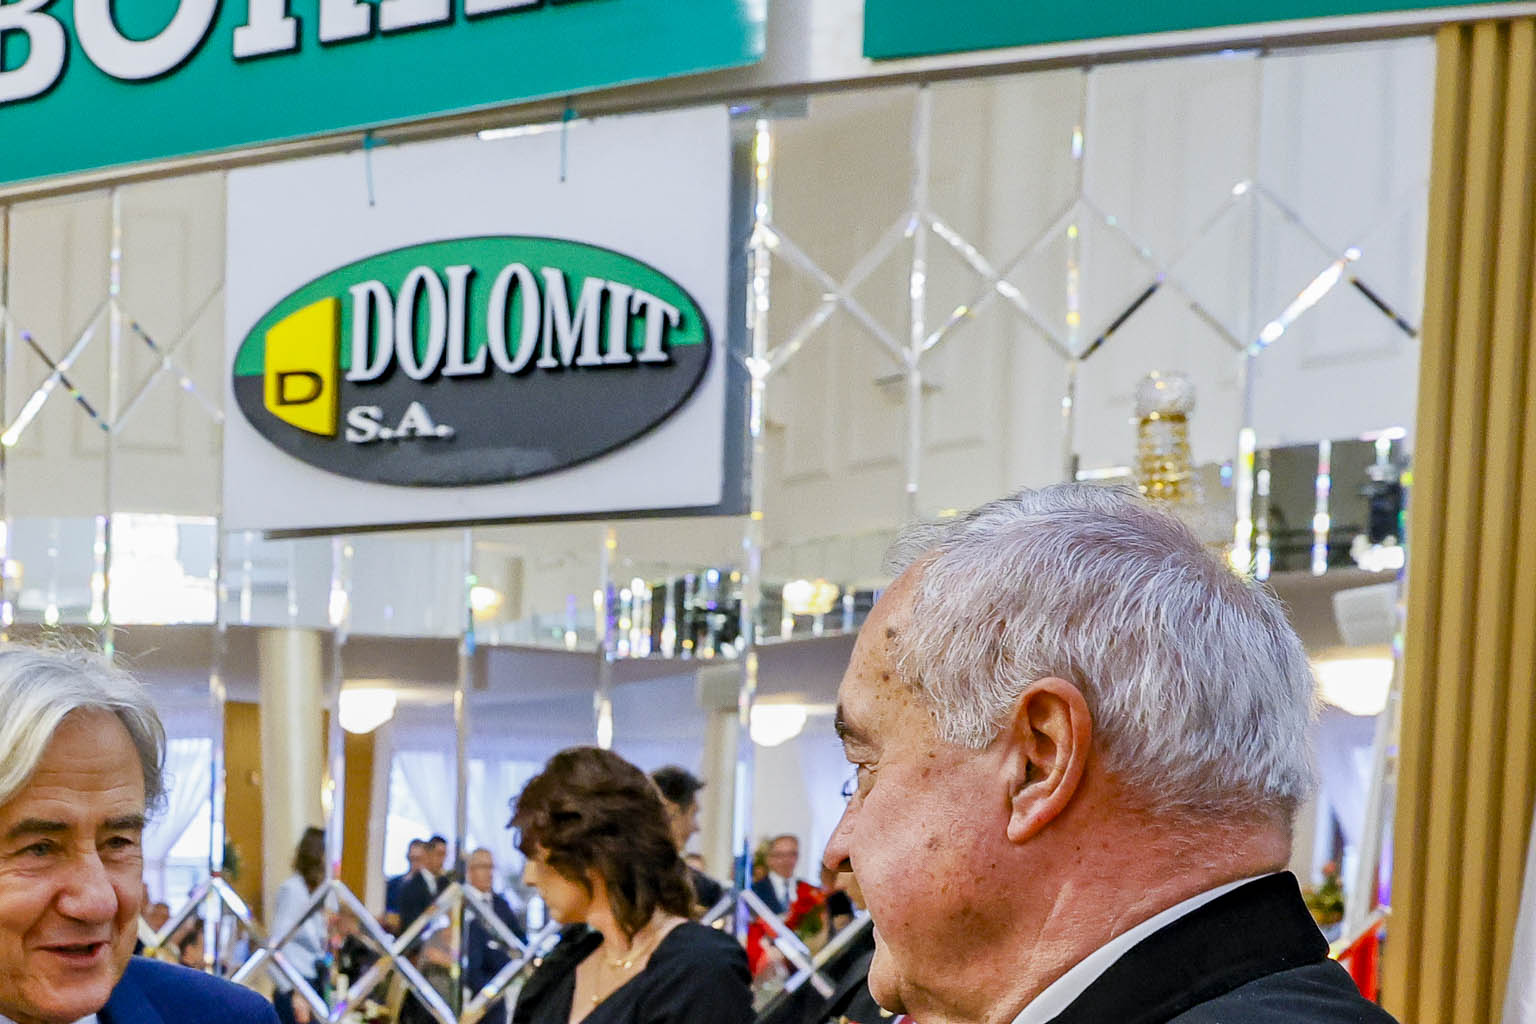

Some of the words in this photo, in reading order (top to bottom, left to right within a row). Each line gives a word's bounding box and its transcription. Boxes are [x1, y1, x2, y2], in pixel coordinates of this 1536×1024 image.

[345, 262, 680, 382] DOLOMIT
[274, 371, 323, 406] D
[346, 401, 454, 443] S.A.
